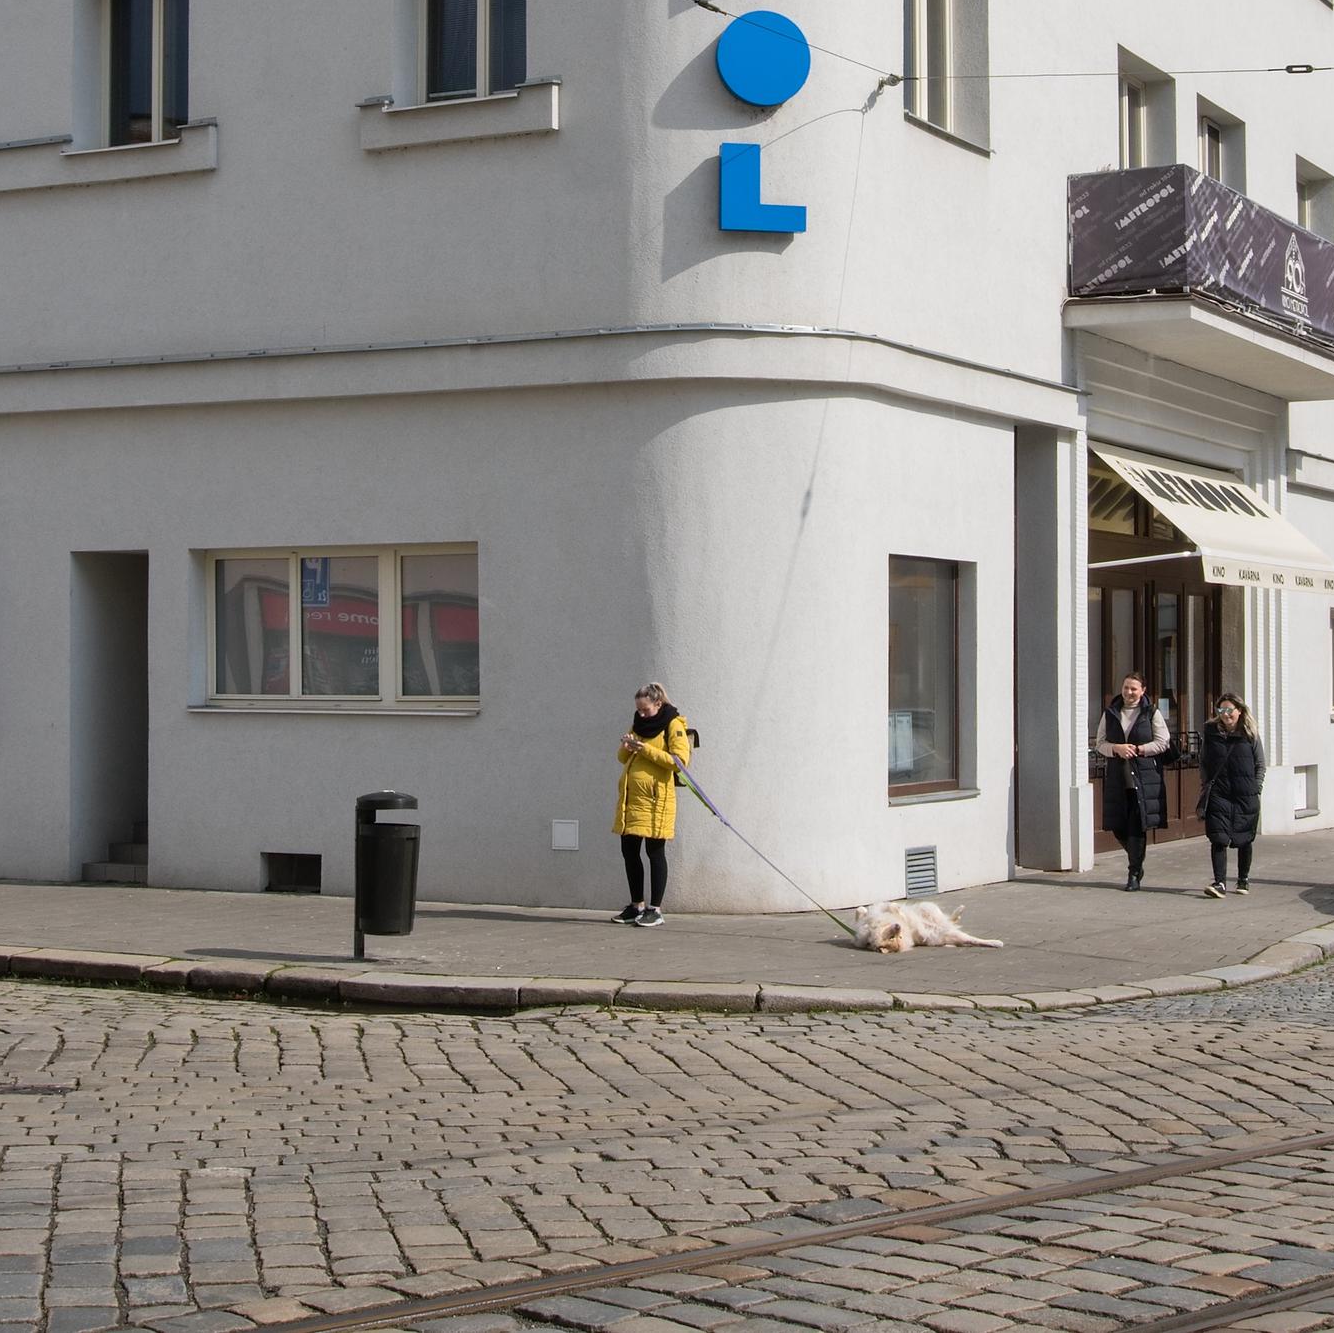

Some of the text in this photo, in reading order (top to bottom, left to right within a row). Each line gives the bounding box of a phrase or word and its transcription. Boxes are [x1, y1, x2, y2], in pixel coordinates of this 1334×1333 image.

[1119, 184, 1175, 228] METROPOL
[1130, 465, 1271, 519] METROPOL
[1212, 566, 1226, 578] KINO
[1272, 573, 1284, 585] KINO
[1324, 579, 1334, 590] KINO
